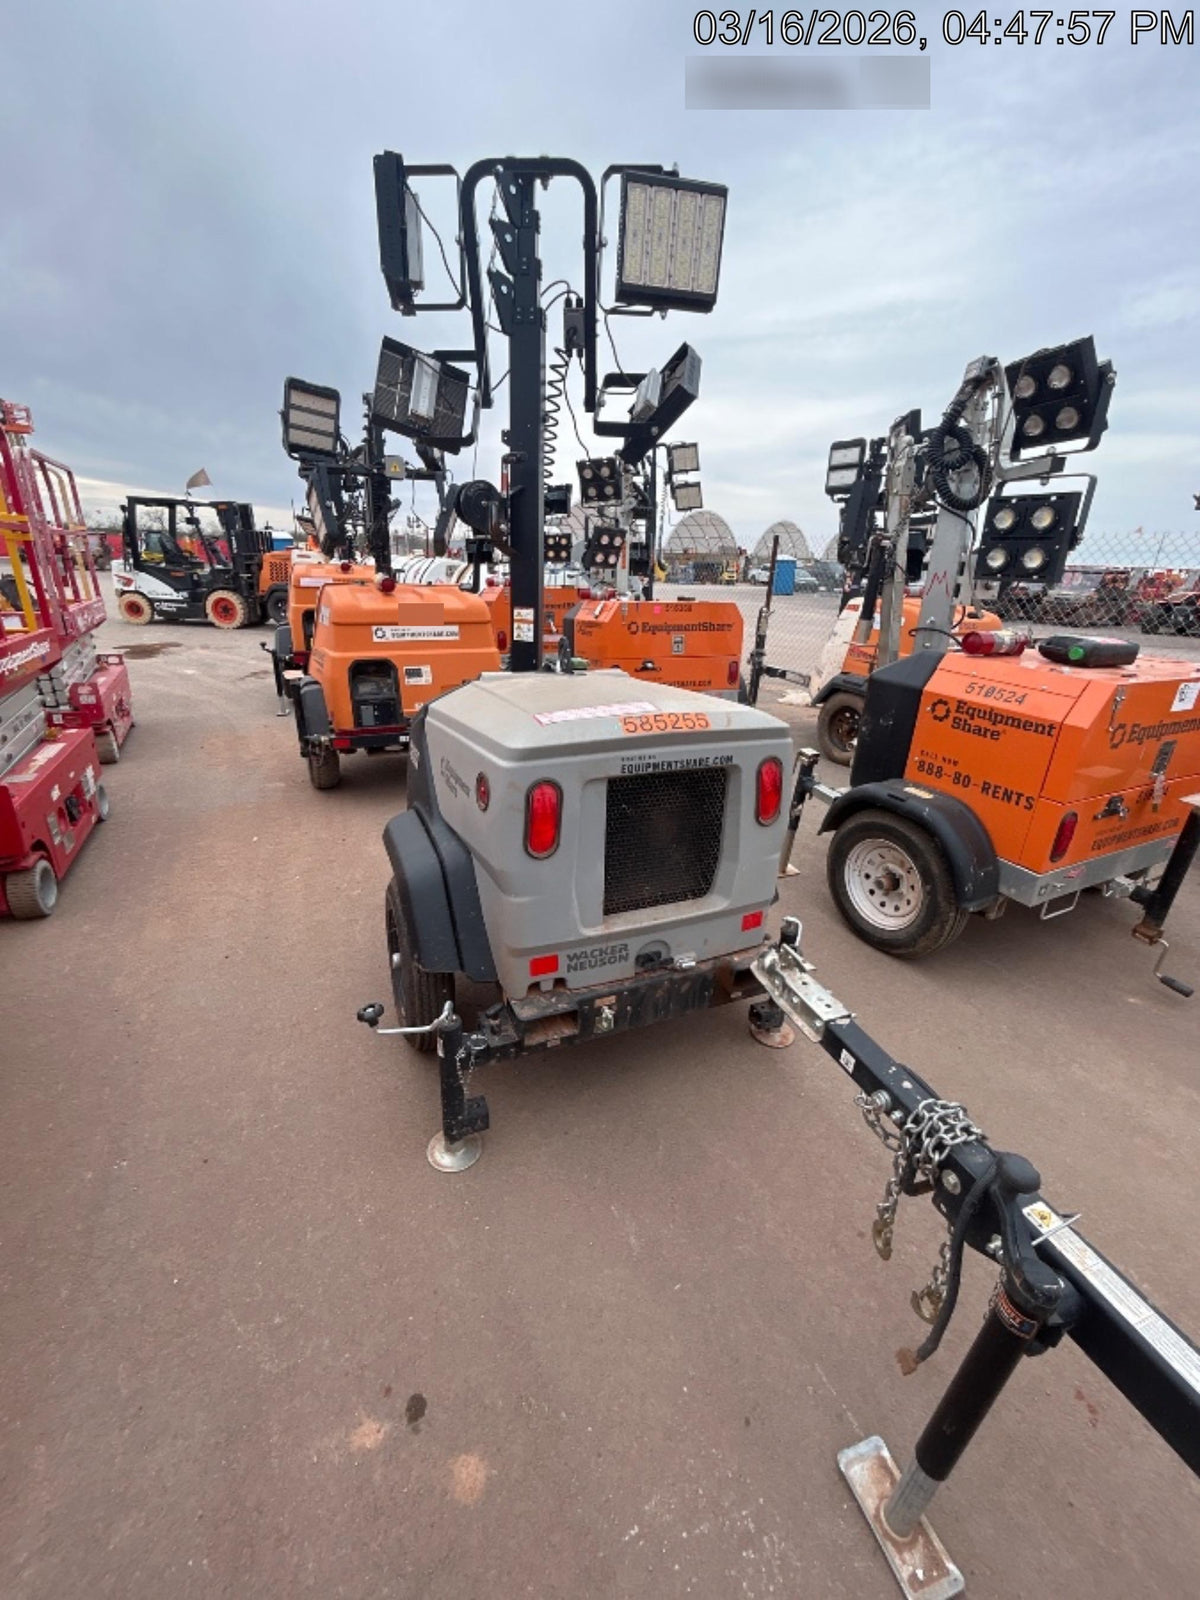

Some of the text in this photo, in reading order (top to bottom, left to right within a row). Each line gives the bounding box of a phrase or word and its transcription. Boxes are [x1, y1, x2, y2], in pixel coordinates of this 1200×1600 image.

[623, 712, 709, 733] 585255
[951, 716, 1001, 741] Share
[955, 700, 1057, 737] Equipment
[621, 755, 734, 774] EQUIPMENTSHARE.COM
[916, 760, 1036, 811] 888-80-RENTS
[566, 943, 629, 963] WACKER
[566, 952, 629, 973] NEUSON
